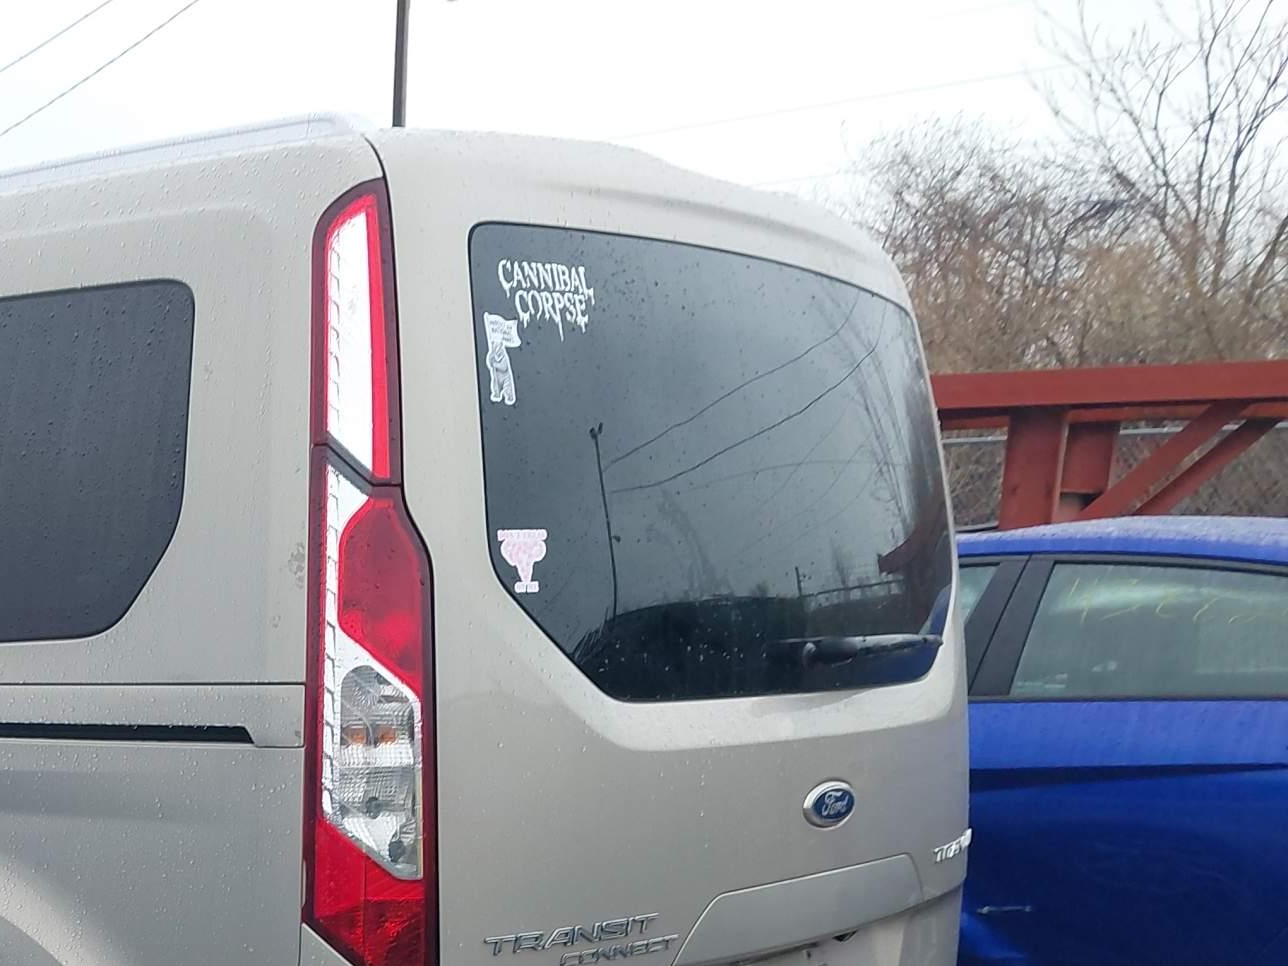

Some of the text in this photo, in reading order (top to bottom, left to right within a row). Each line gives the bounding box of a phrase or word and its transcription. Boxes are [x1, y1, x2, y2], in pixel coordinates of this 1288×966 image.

[498, 259, 595, 306] CANNIBAL
[514, 289, 589, 341] CORPSE
[483, 912, 660, 956] TRANSIT
